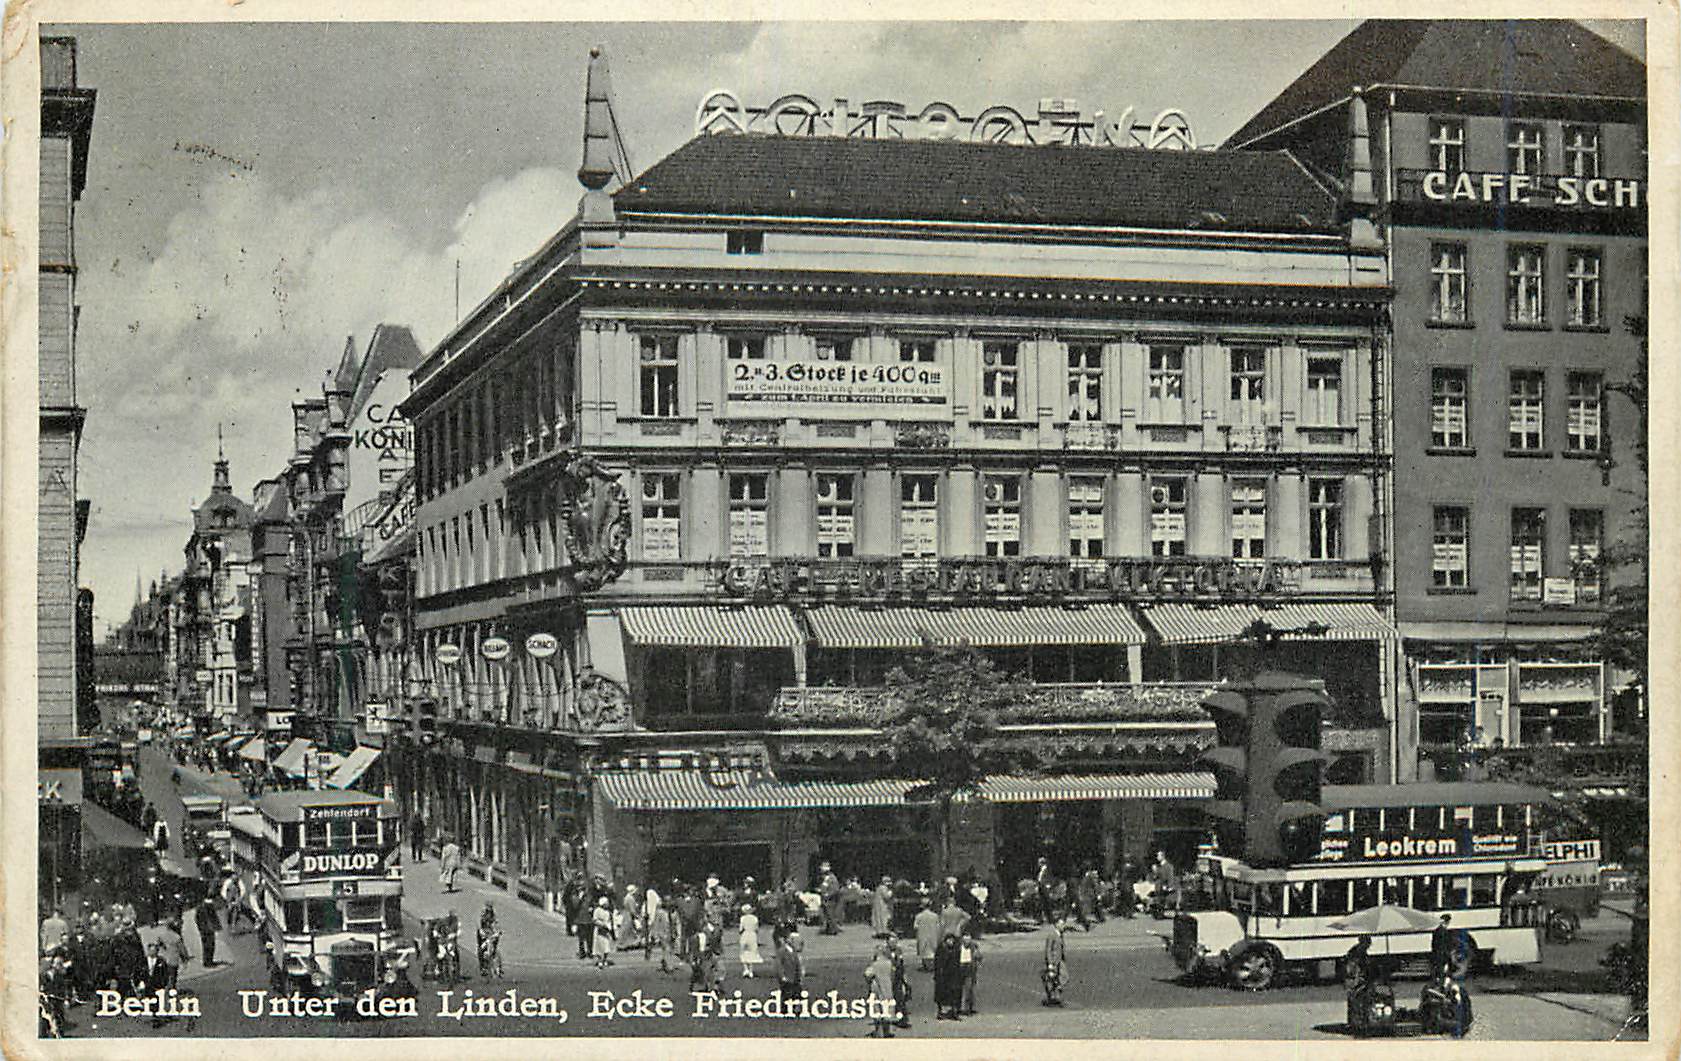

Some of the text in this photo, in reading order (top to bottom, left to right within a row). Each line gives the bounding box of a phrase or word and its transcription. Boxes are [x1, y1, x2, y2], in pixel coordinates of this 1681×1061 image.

[1422, 171, 1530, 203] CAFE
[852, 366, 867, 383] je
[872, 366, 916, 383] 400
[309, 808, 370, 819] Zehlendorf
[1364, 836, 1456, 858] Leokrem
[303, 853, 379, 873] DUNLOP
